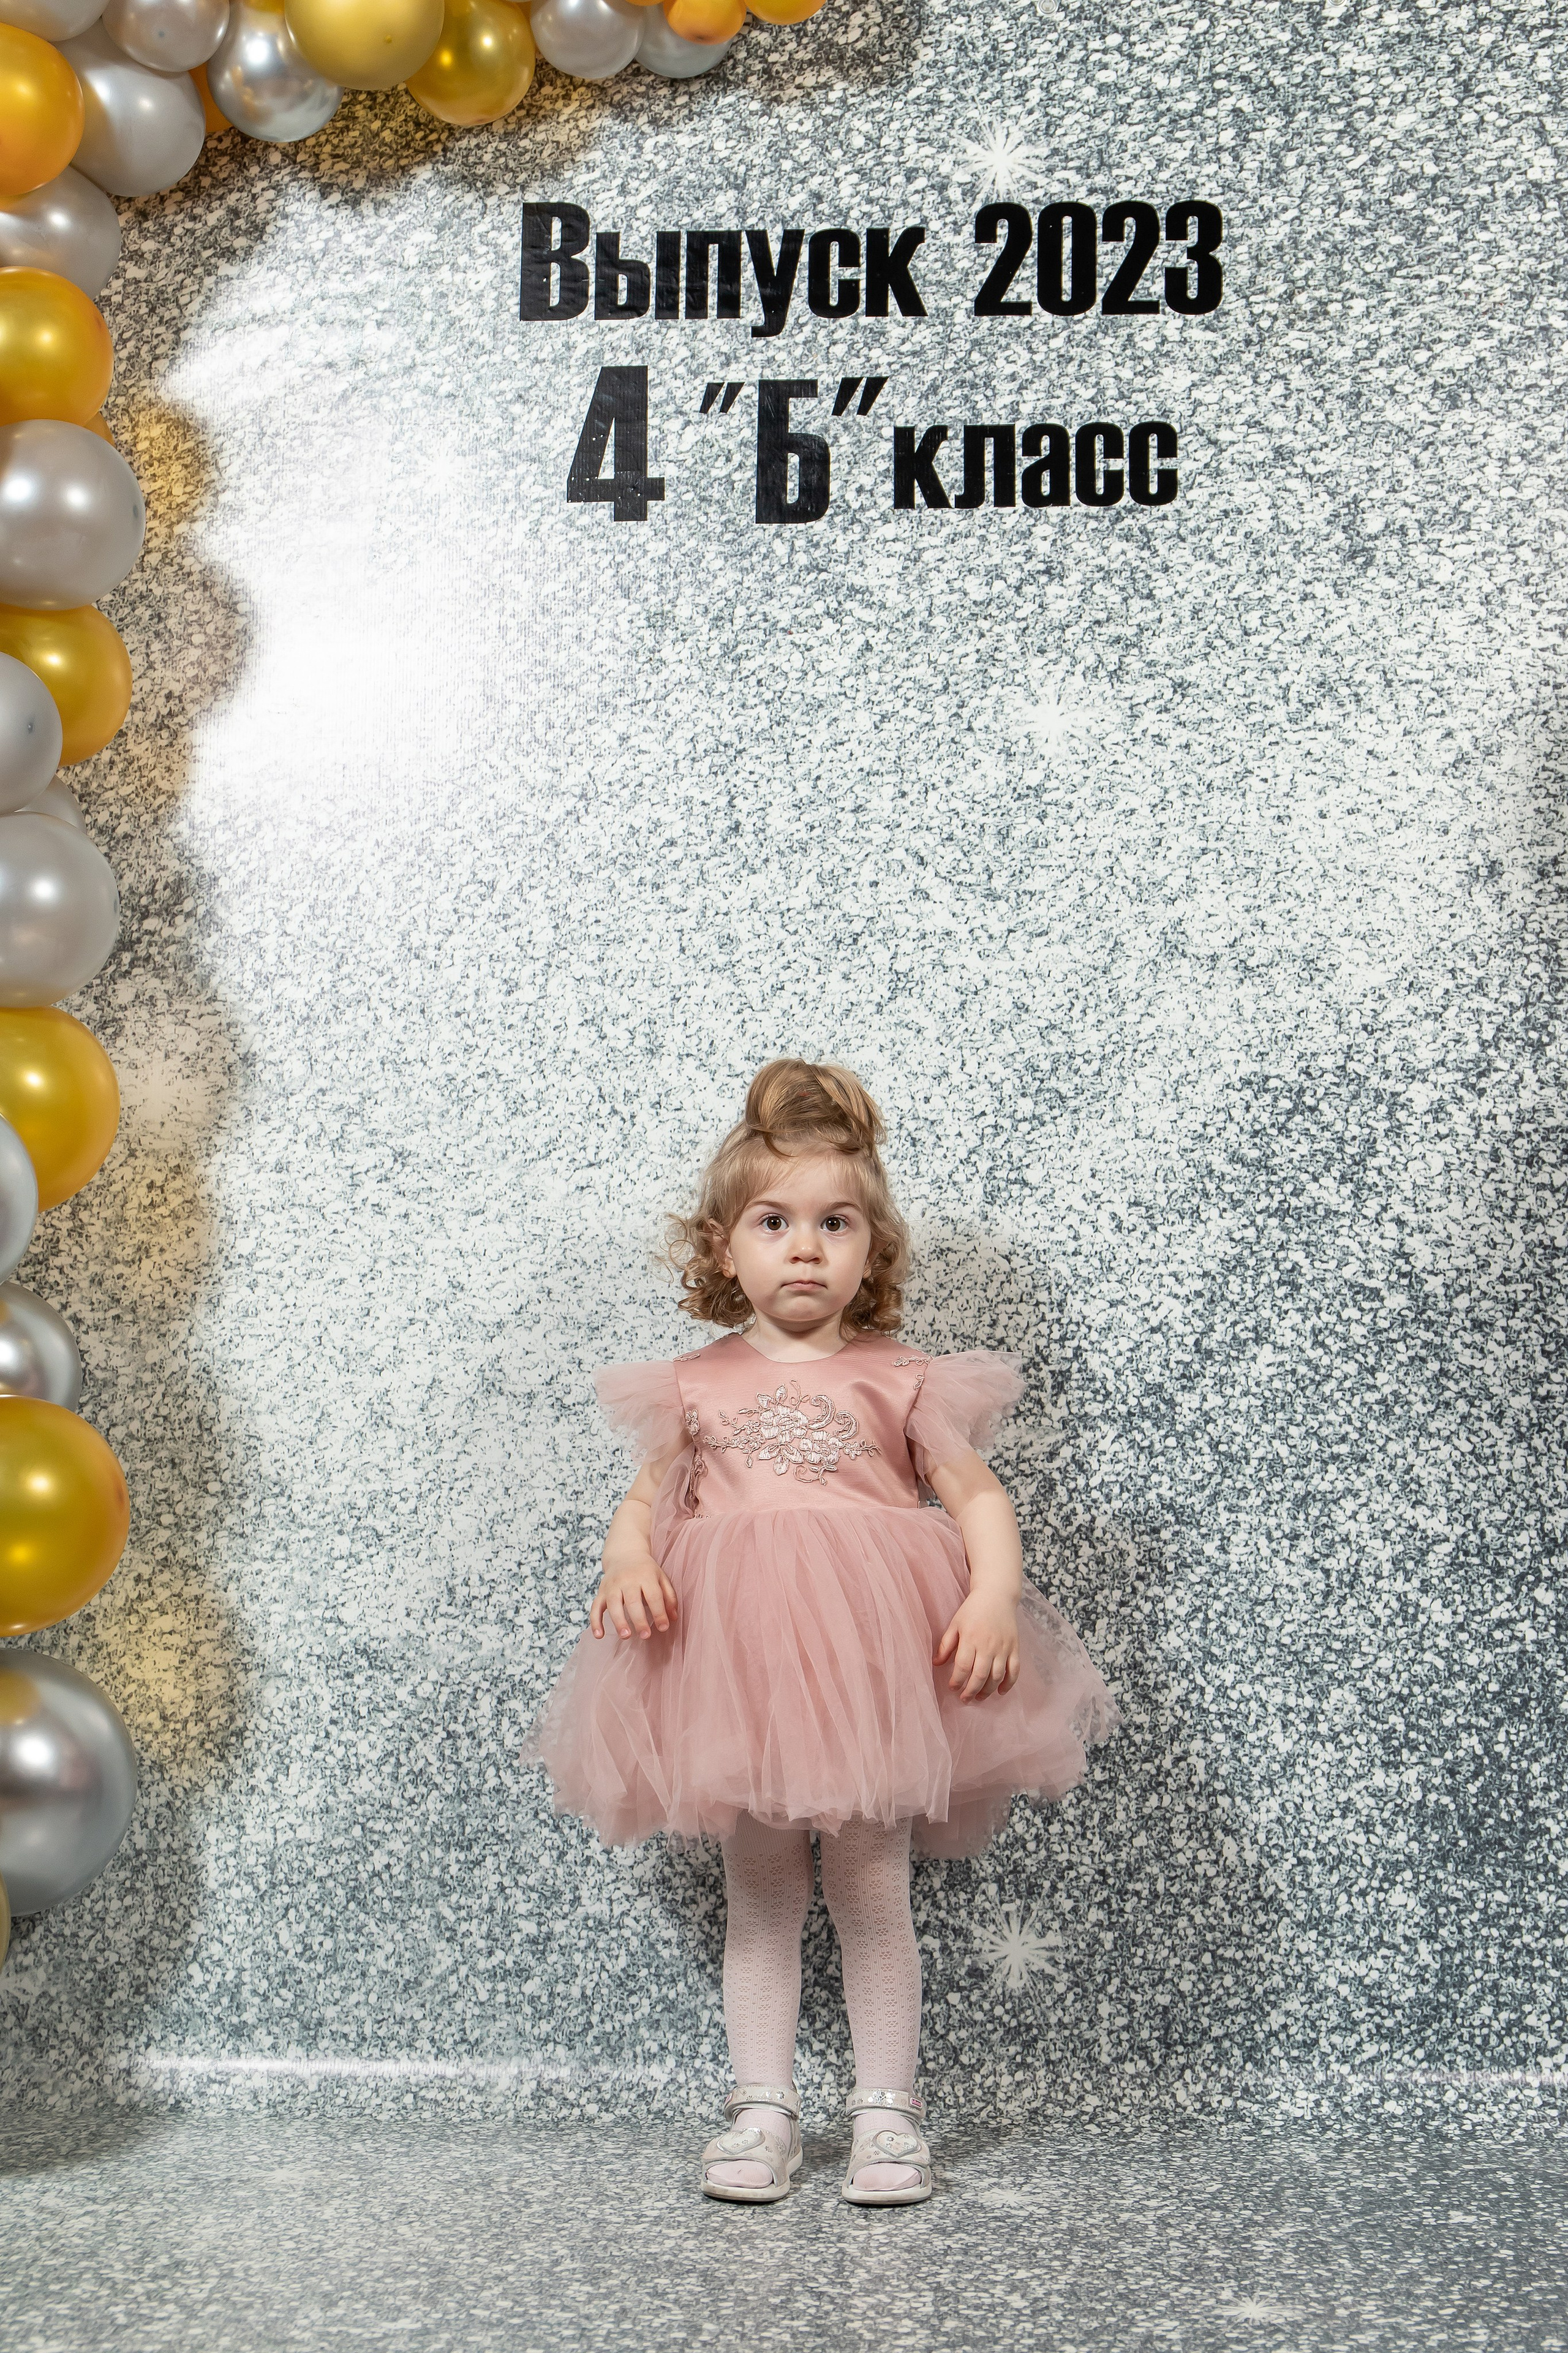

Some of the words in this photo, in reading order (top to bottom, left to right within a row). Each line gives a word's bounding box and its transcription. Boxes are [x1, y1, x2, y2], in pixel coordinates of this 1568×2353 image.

[519, 201, 929, 338] Выпуск
[973, 200, 1223, 317] 2023
[567, 366, 665, 522] 4
[893, 421, 1178, 510] класс
